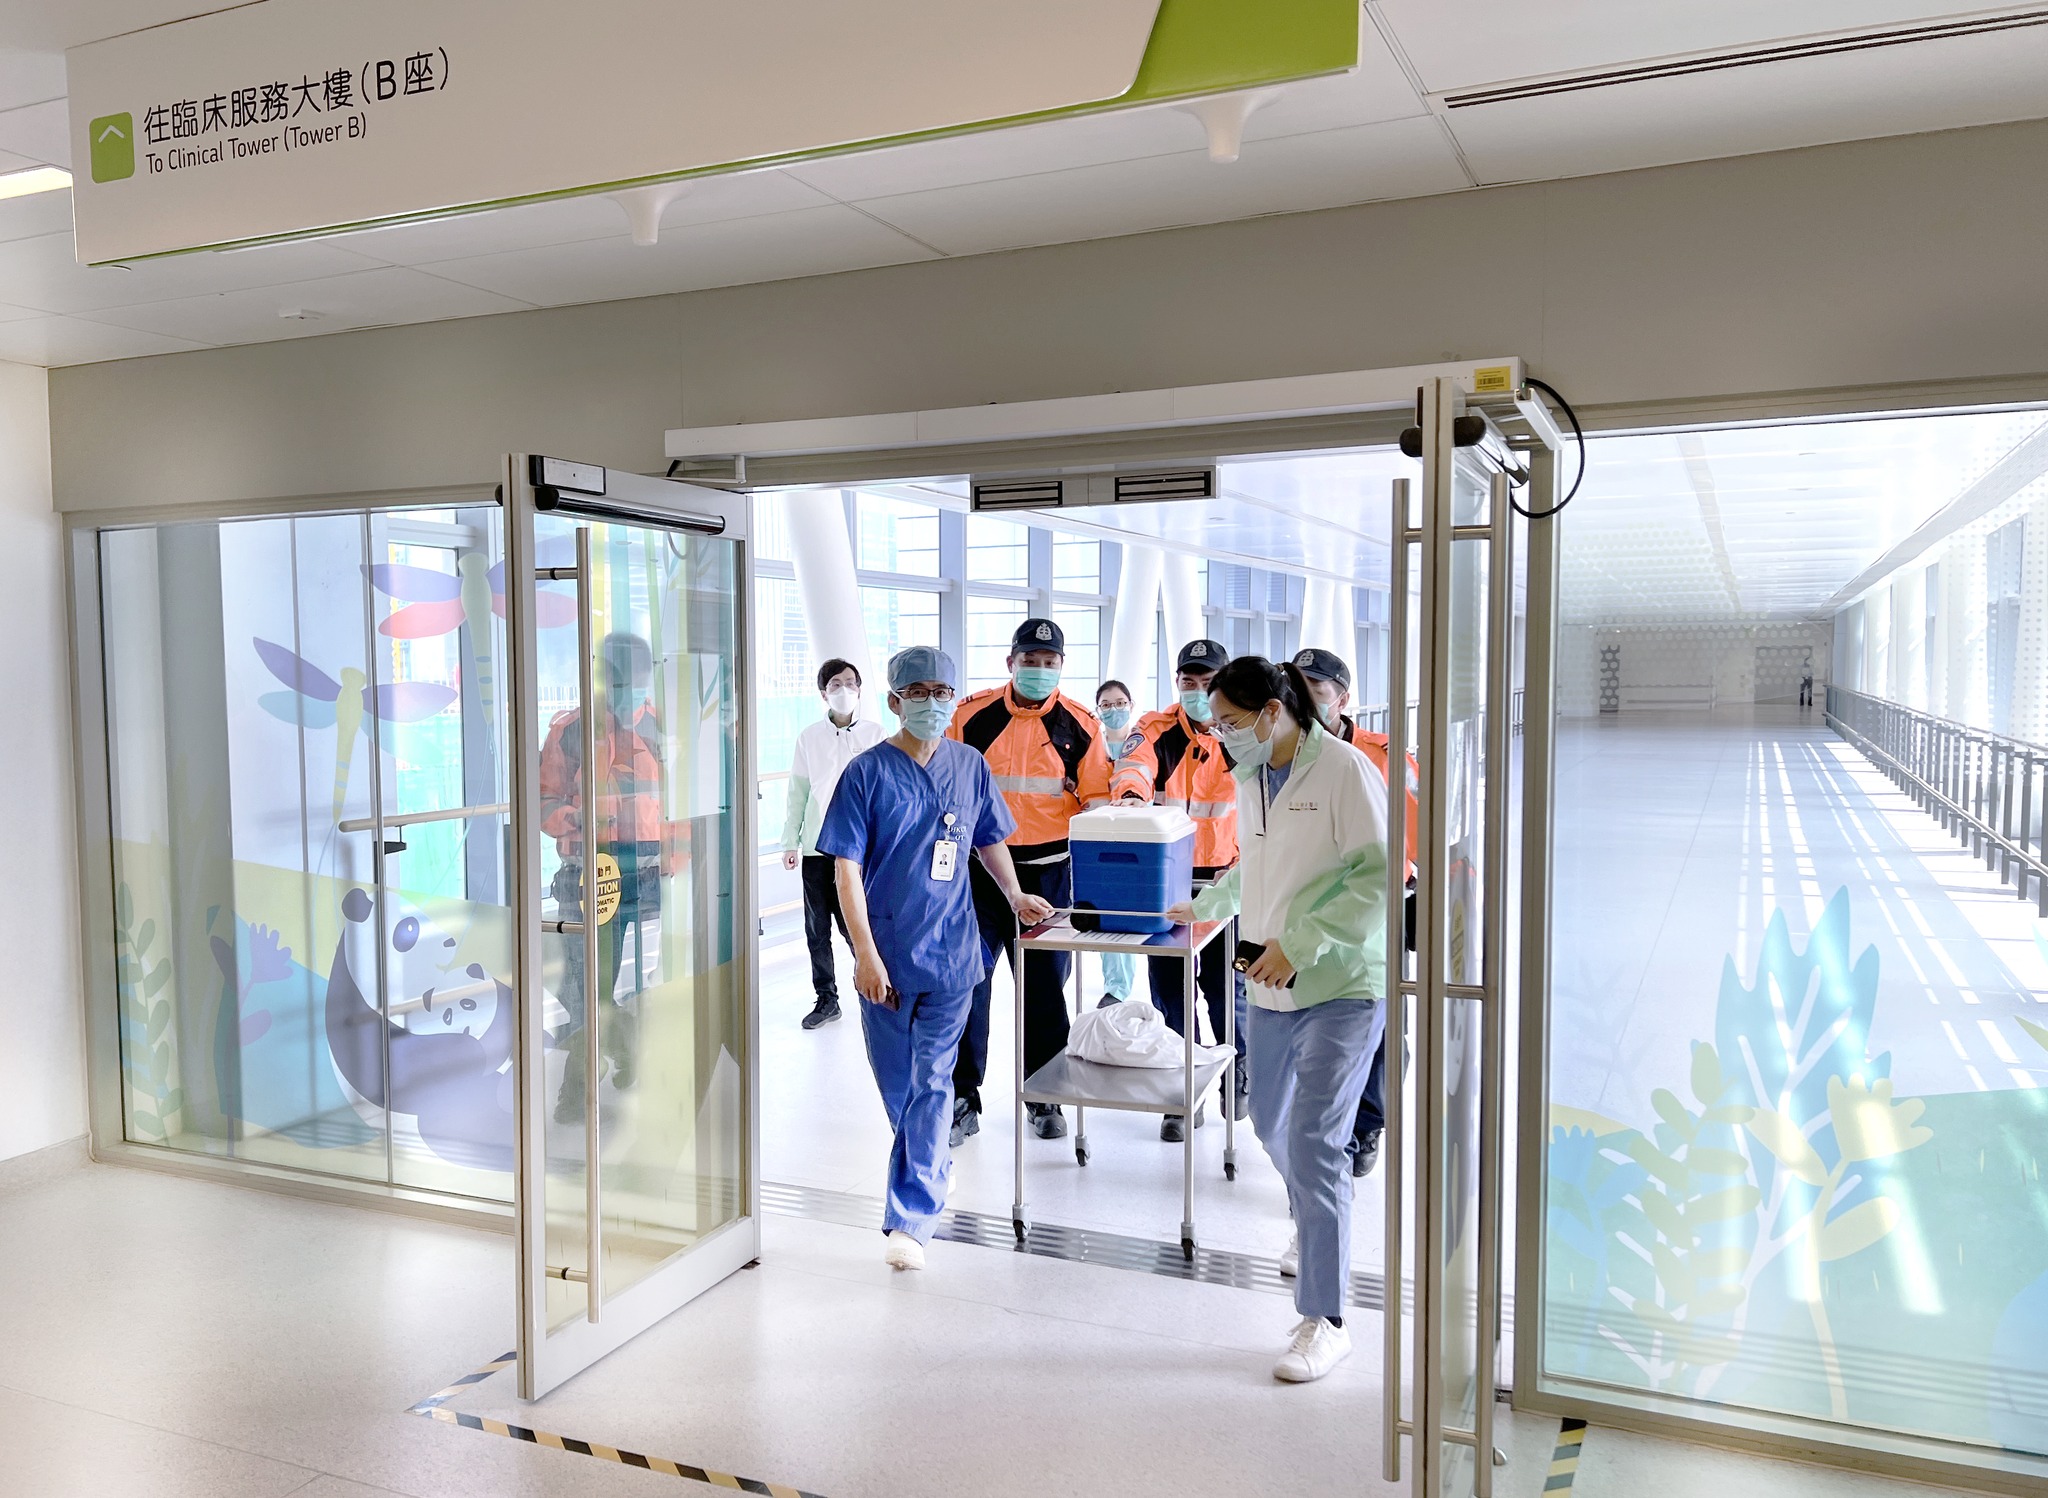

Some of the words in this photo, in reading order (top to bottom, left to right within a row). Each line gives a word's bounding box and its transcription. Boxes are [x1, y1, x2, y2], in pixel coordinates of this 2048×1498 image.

[145, 152, 163, 175] To
[168, 140, 224, 170] Clinical
[228, 136, 279, 159] Tower
[284, 124, 343, 152] (Tower
[349, 111, 367, 139] B)
